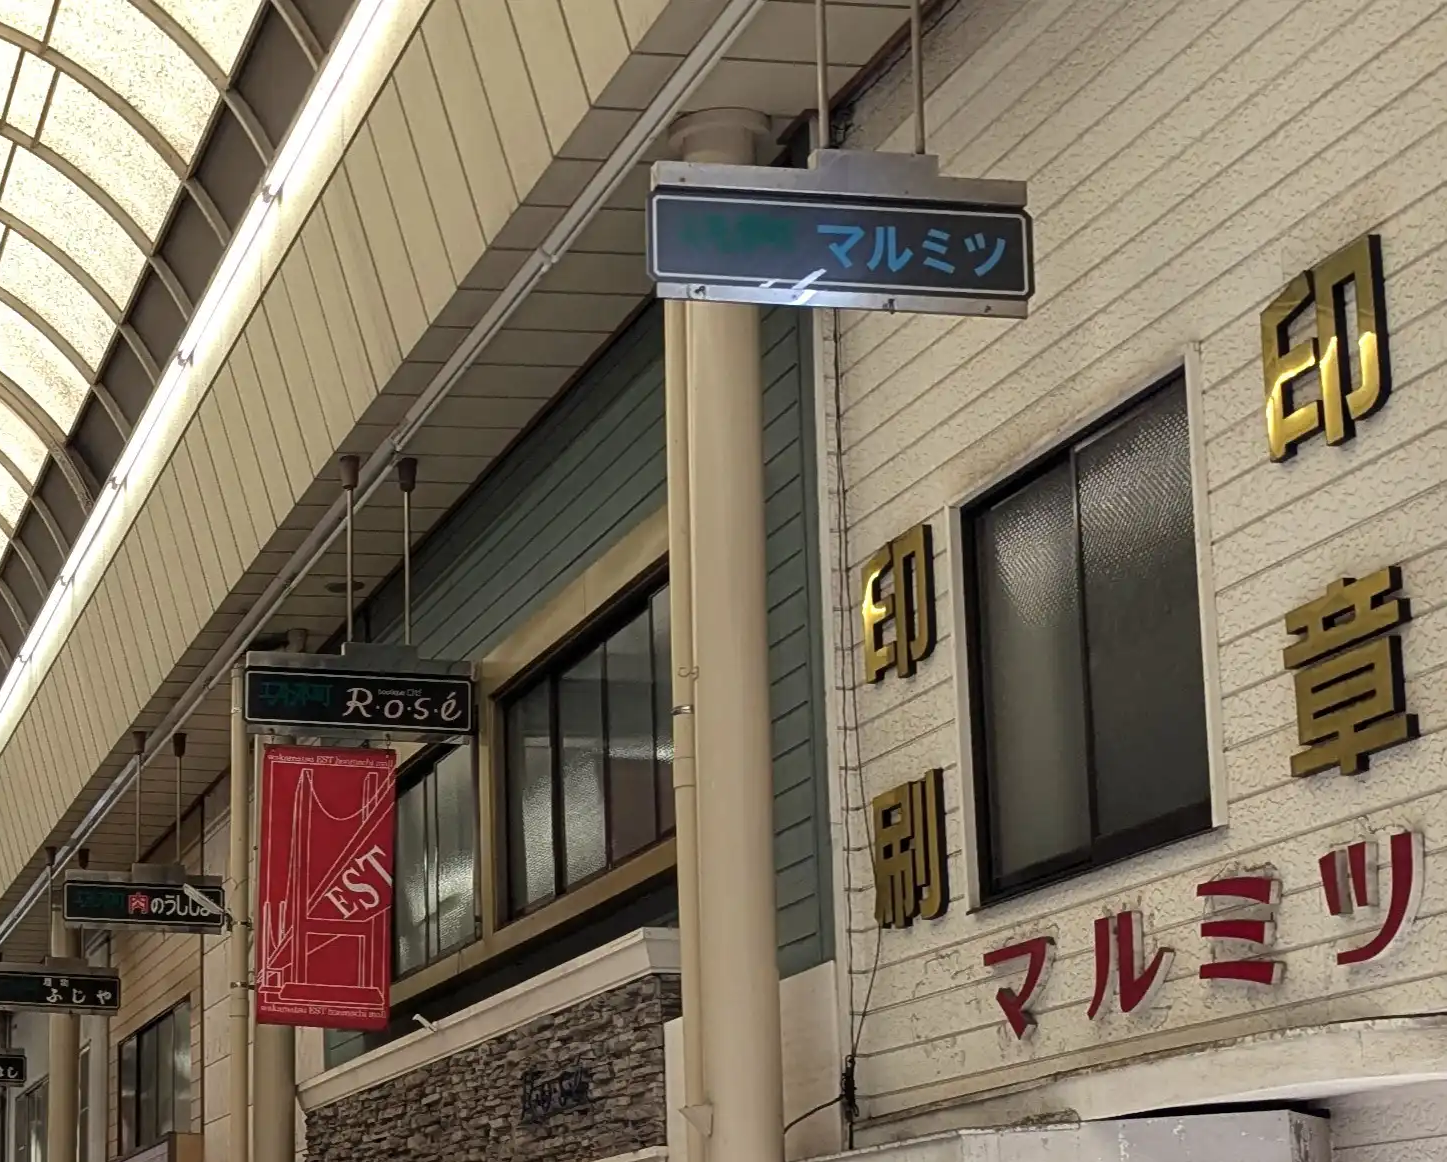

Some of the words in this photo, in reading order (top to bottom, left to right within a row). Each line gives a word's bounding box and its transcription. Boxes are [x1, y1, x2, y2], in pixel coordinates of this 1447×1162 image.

[816, 224, 1006, 277] マルミツ
[323, 844, 393, 920] EST
[983, 831, 1425, 1041] マルミツ
[45, 988, 113, 1006] ふじや
